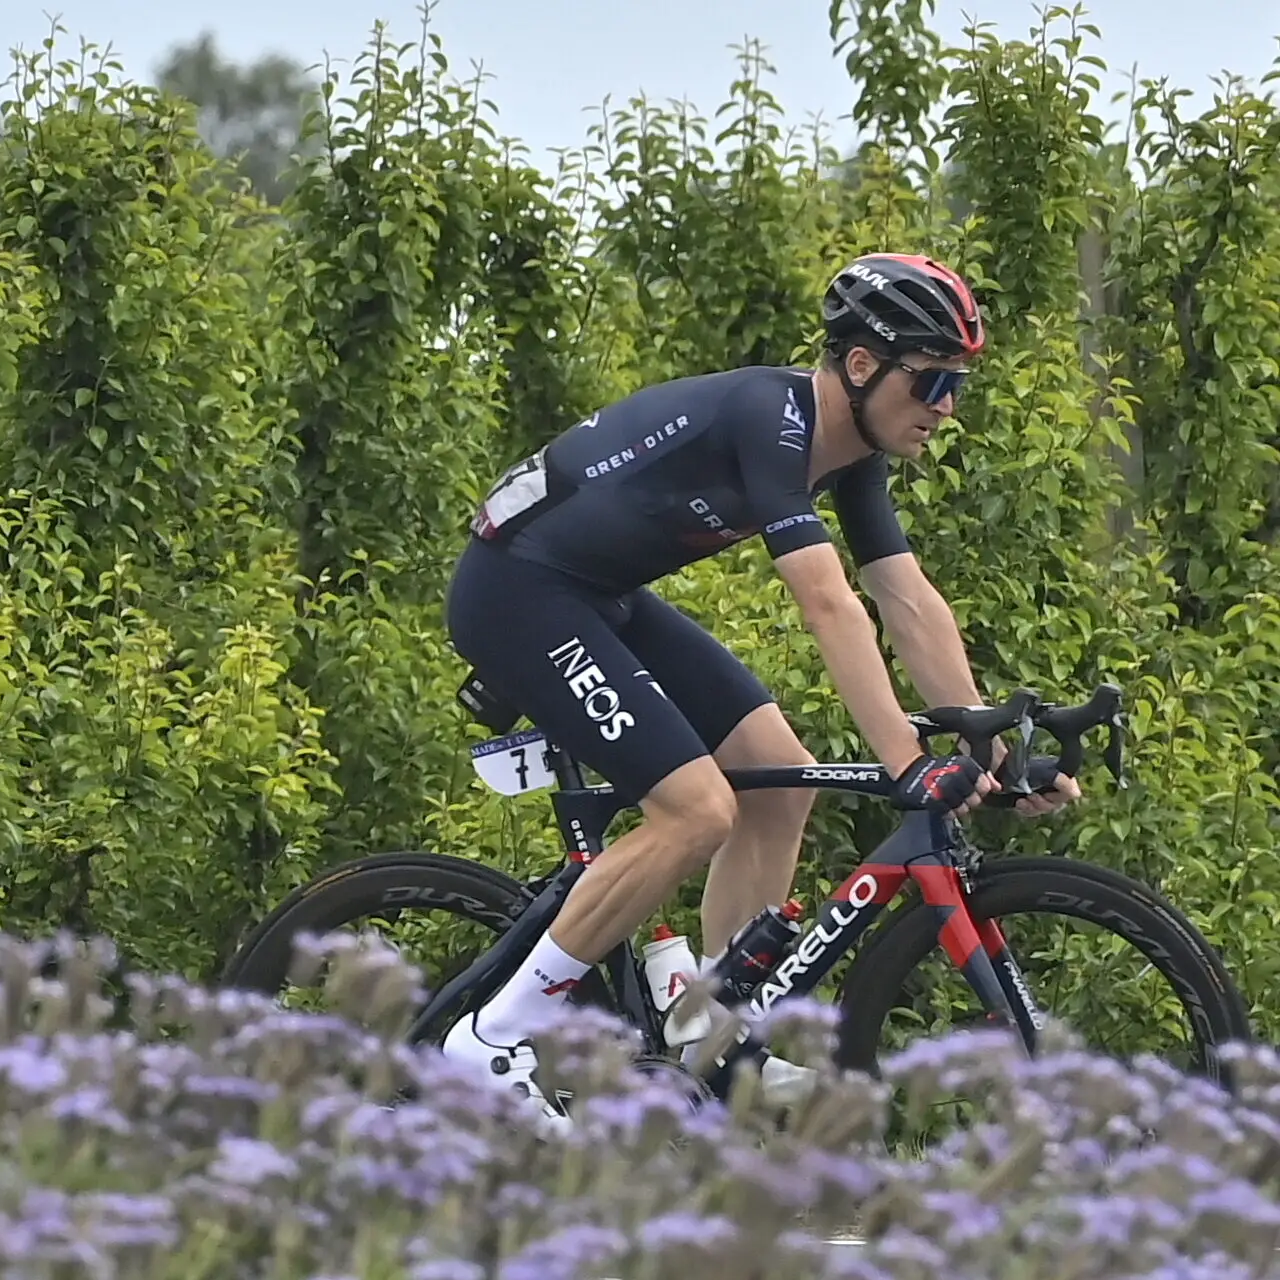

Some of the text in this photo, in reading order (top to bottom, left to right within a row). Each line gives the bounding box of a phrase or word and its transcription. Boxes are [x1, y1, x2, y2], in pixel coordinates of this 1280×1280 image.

[584, 415, 690, 479] GRENADIER
[547, 636, 636, 741] INEOS
[510, 748, 529, 789] 7
[801, 769, 880, 782] DOGMA
